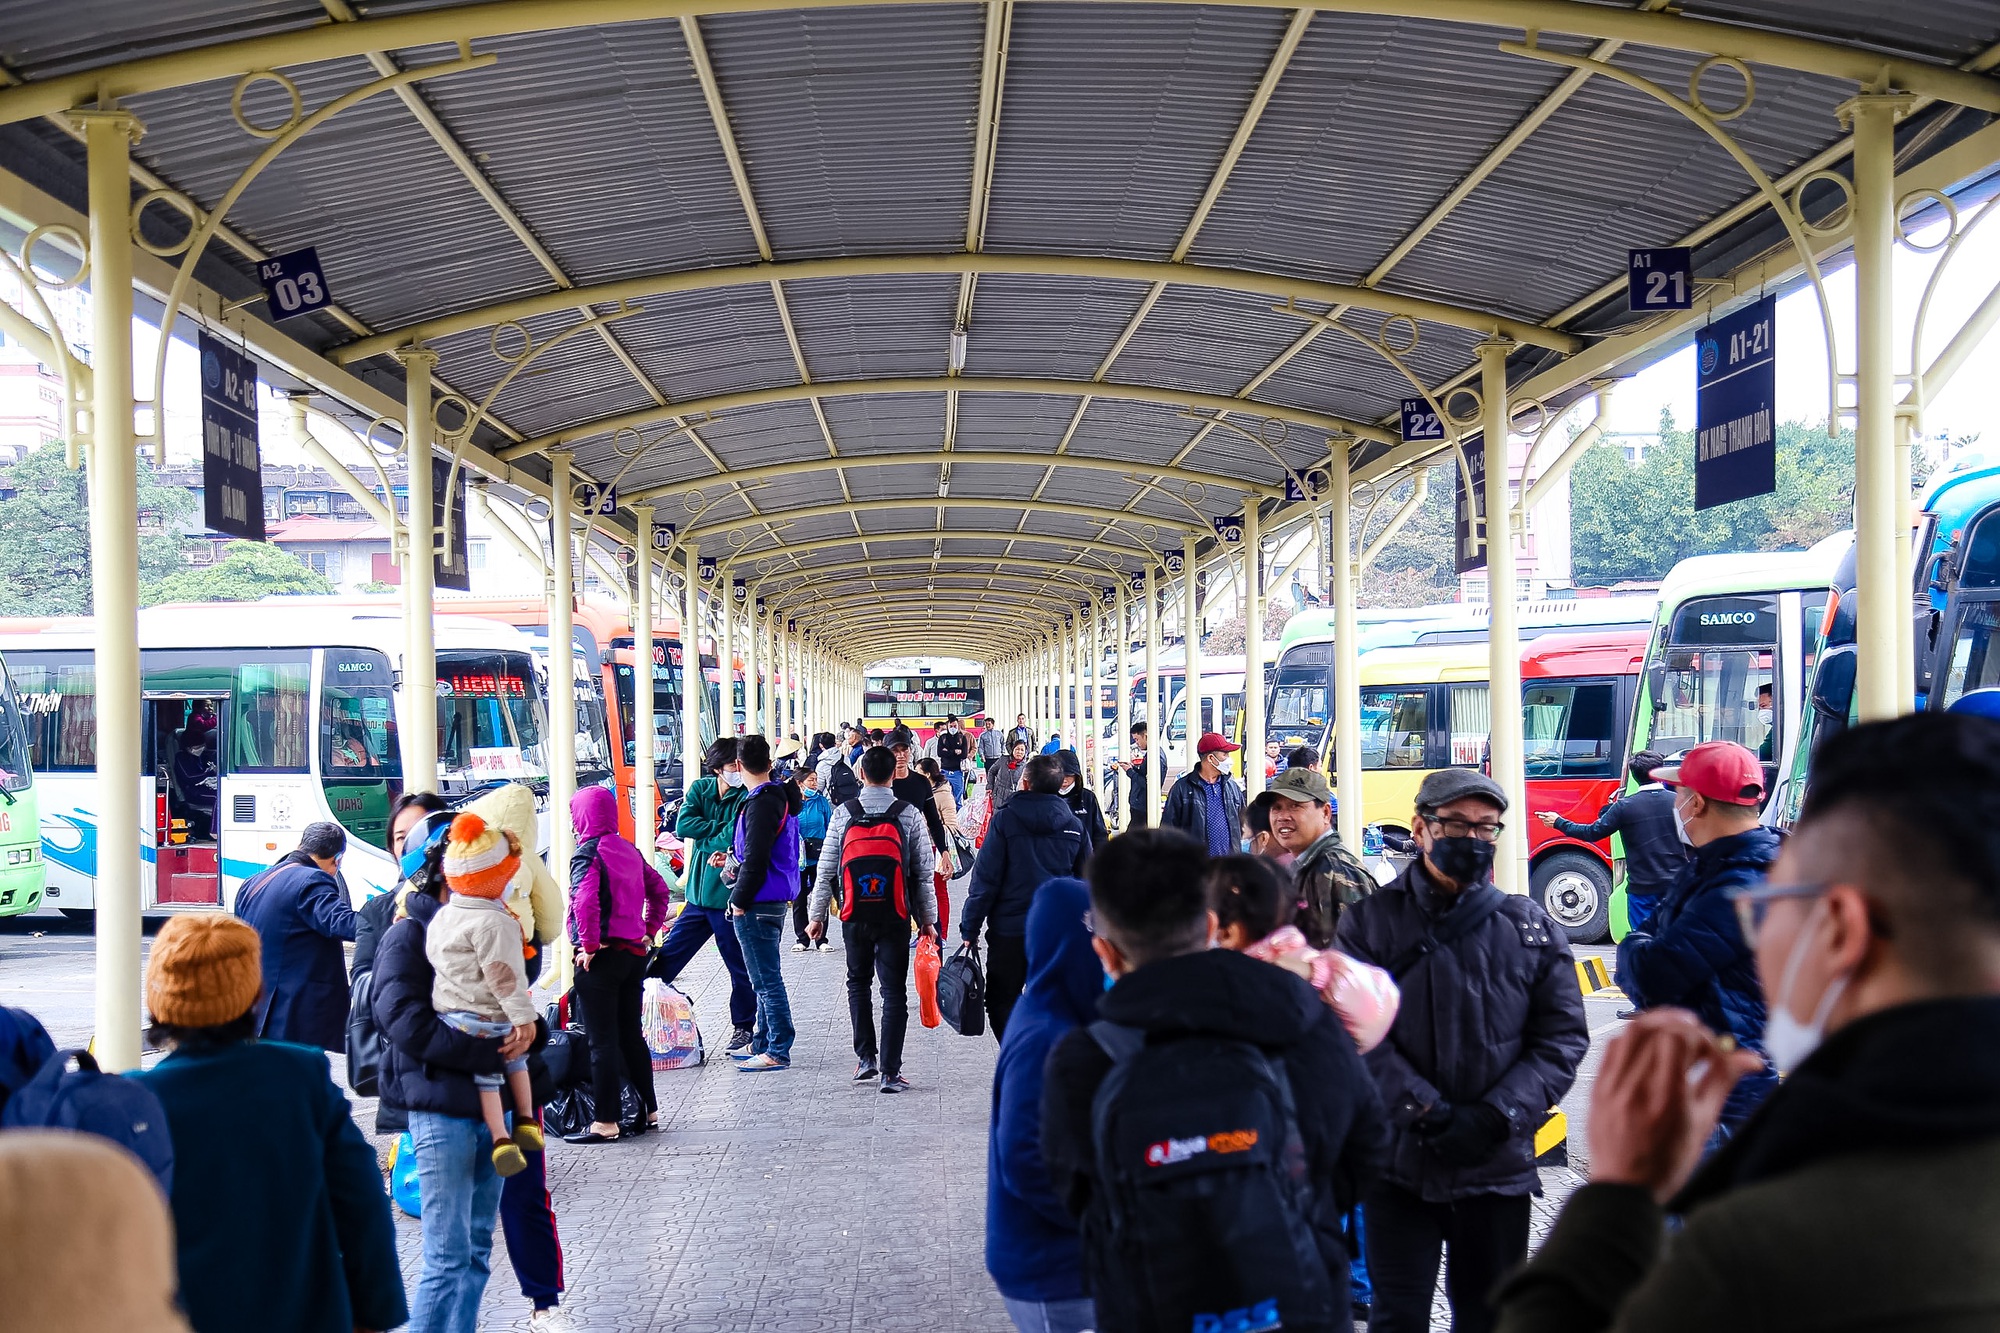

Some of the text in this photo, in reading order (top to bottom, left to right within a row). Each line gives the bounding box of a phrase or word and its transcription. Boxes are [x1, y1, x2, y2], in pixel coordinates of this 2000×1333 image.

[1633, 254, 1651, 268] A1
[262, 262, 283, 279] A2
[275, 272, 323, 311] 03
[1645, 271, 1685, 304] 21
[1729, 319, 1769, 365] A1-21
[225, 368, 256, 411] A2-03
[1404, 401, 1416, 412] A1
[1410, 413, 1441, 437] 22
[1168, 558, 1183, 569] 25
[1699, 611, 1757, 626] SAMCO
[338, 662, 374, 673] SAMCO
[938, 692, 968, 701] LAN
